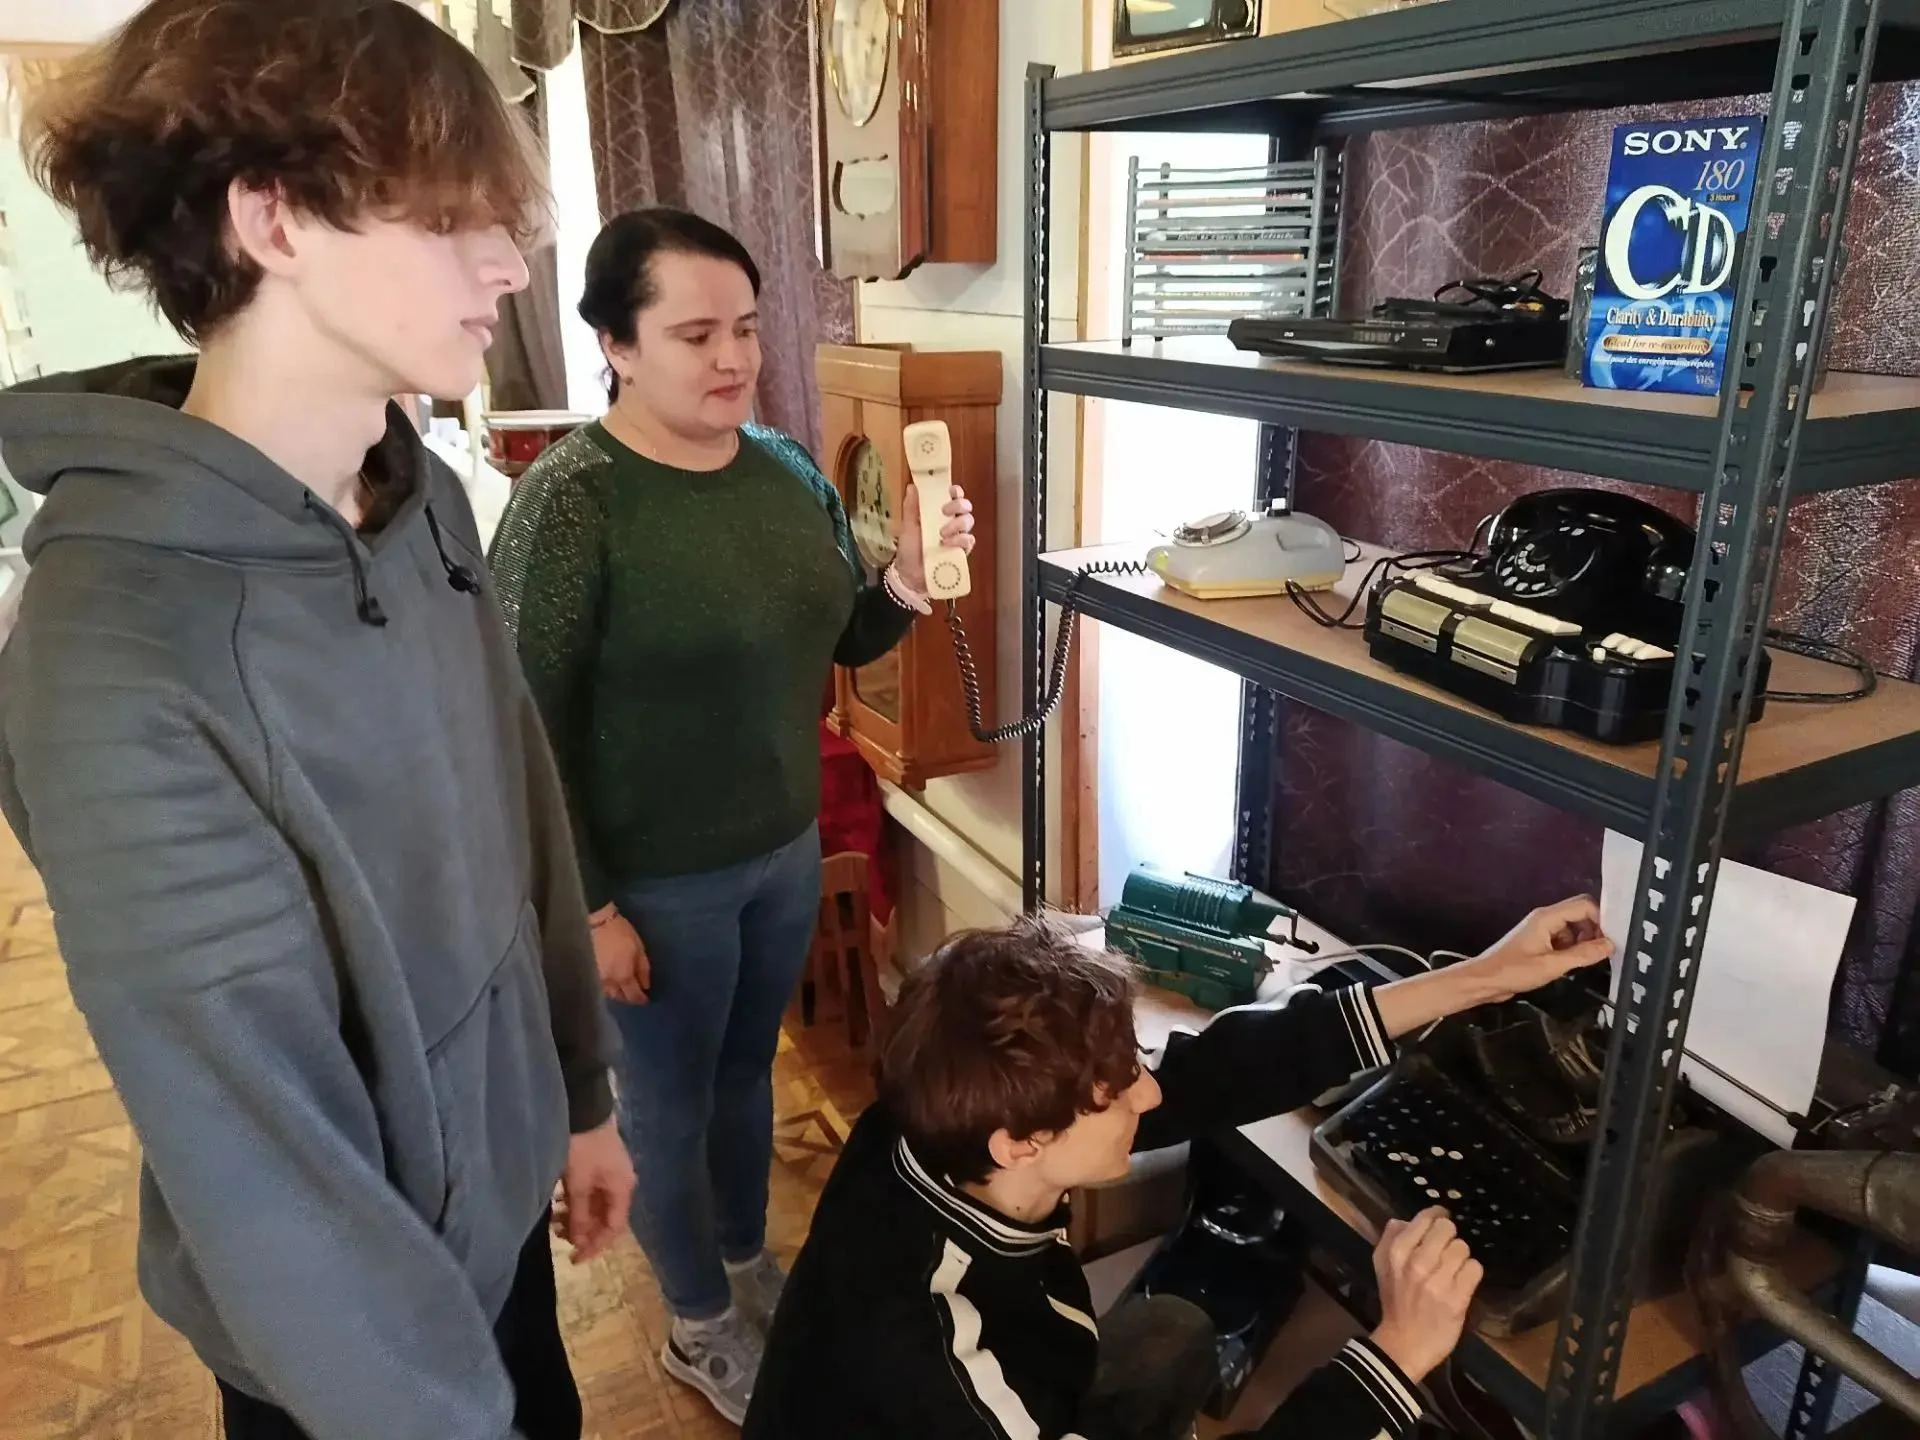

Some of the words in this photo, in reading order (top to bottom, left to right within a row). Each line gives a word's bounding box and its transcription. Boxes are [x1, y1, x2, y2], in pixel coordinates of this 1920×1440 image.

[1624, 126, 1749, 156] SONY
[1694, 159, 1745, 191] 180
[1604, 184, 1736, 300] CD
[1606, 307, 1644, 329] Clarity
[1645, 308, 1657, 326] &
[1659, 308, 1716, 332] Durability
[1631, 337, 1647, 350] for
